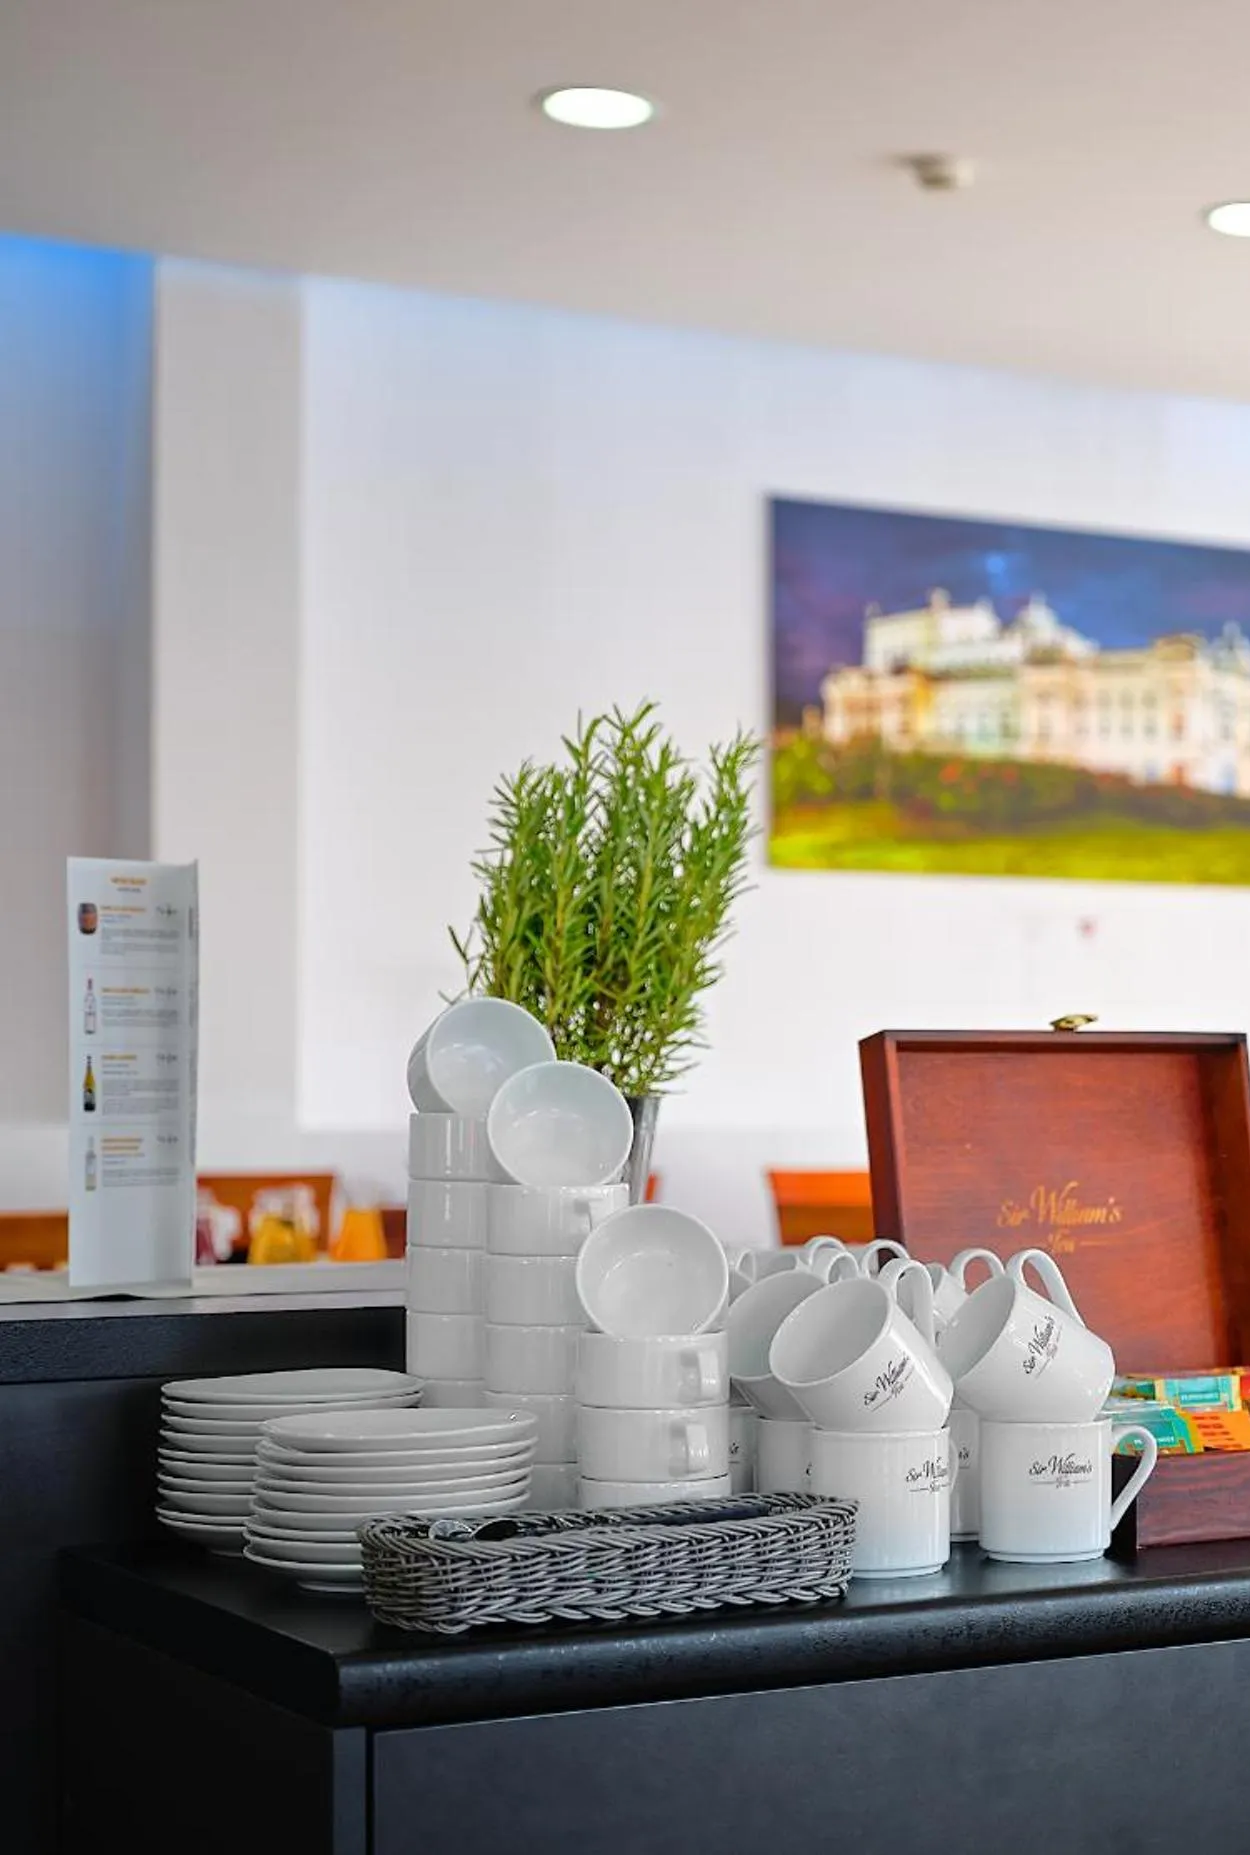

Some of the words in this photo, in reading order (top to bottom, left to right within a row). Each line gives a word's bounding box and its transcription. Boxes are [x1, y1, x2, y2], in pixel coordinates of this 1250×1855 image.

[863, 1389, 881, 1407] Sir
[1028, 1460, 1048, 1476] Sir
[1047, 1452, 1093, 1476] William's
[905, 1466, 922, 1482] Sir
